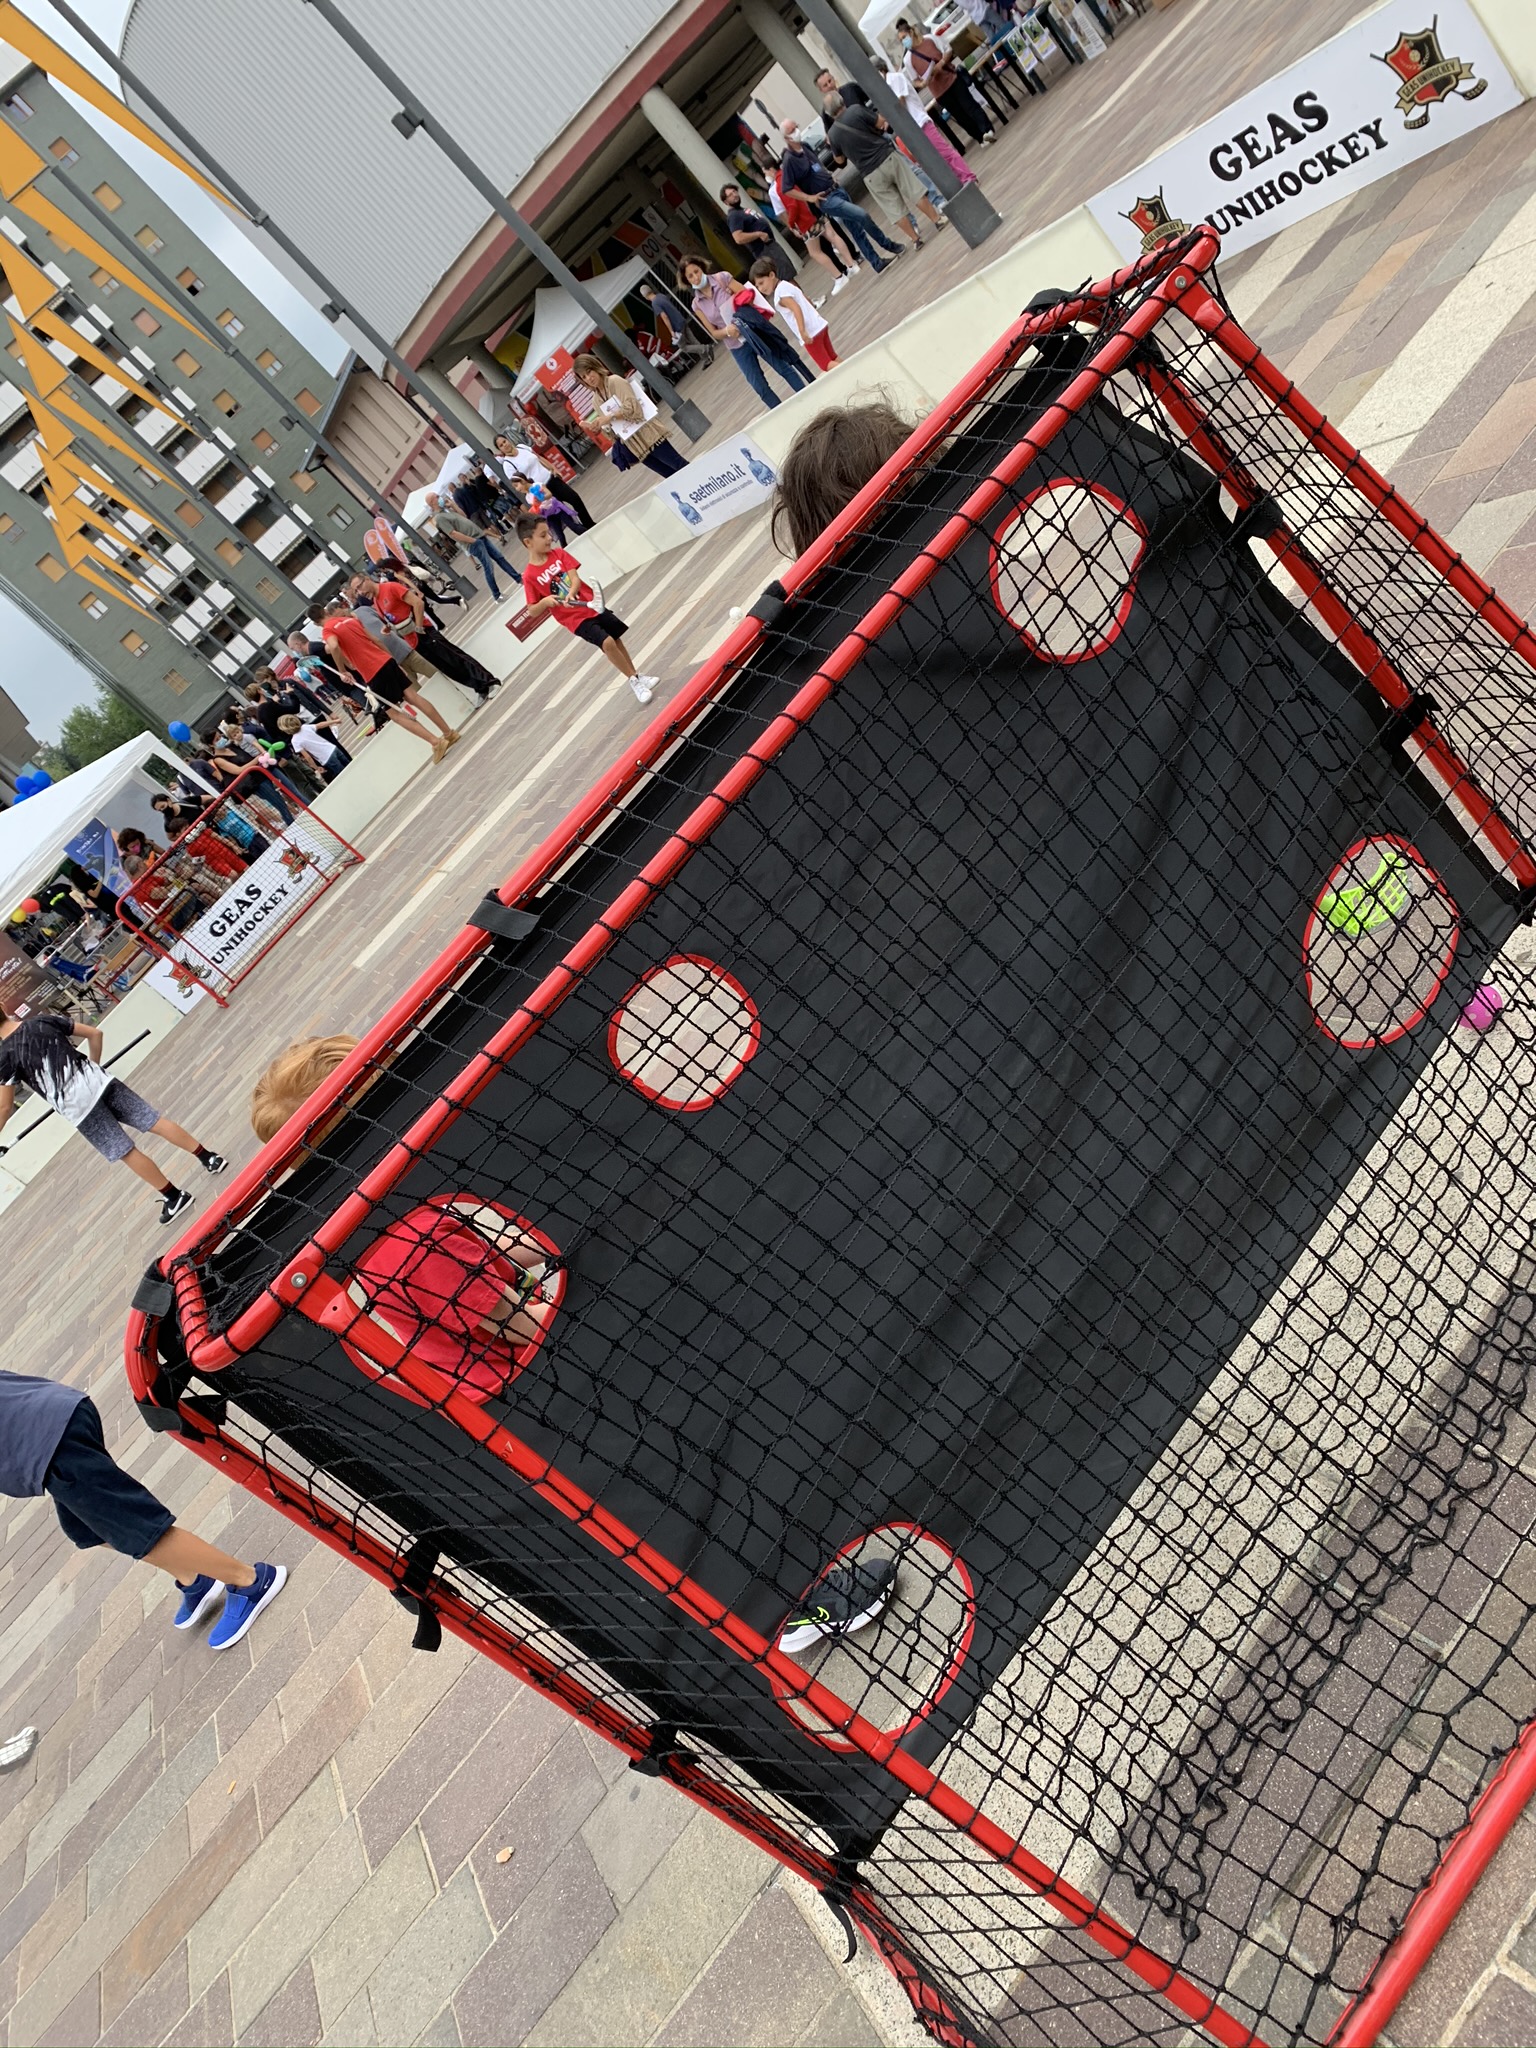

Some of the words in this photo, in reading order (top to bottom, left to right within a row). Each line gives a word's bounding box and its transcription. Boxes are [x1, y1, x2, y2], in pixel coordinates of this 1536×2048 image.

[1402, 79, 1420, 98] GEAS
[1419, 61, 1456, 84] UNIHOCKEY
[1209, 90, 1329, 182] GEAS
[1204, 117, 1389, 236] UNIHOCKEY
[689, 463, 746, 504] saetmilano.it
[536, 559, 563, 586] NASA
[209, 883, 262, 937] GEAS
[210, 883, 289, 965] UNIHOCKEY
